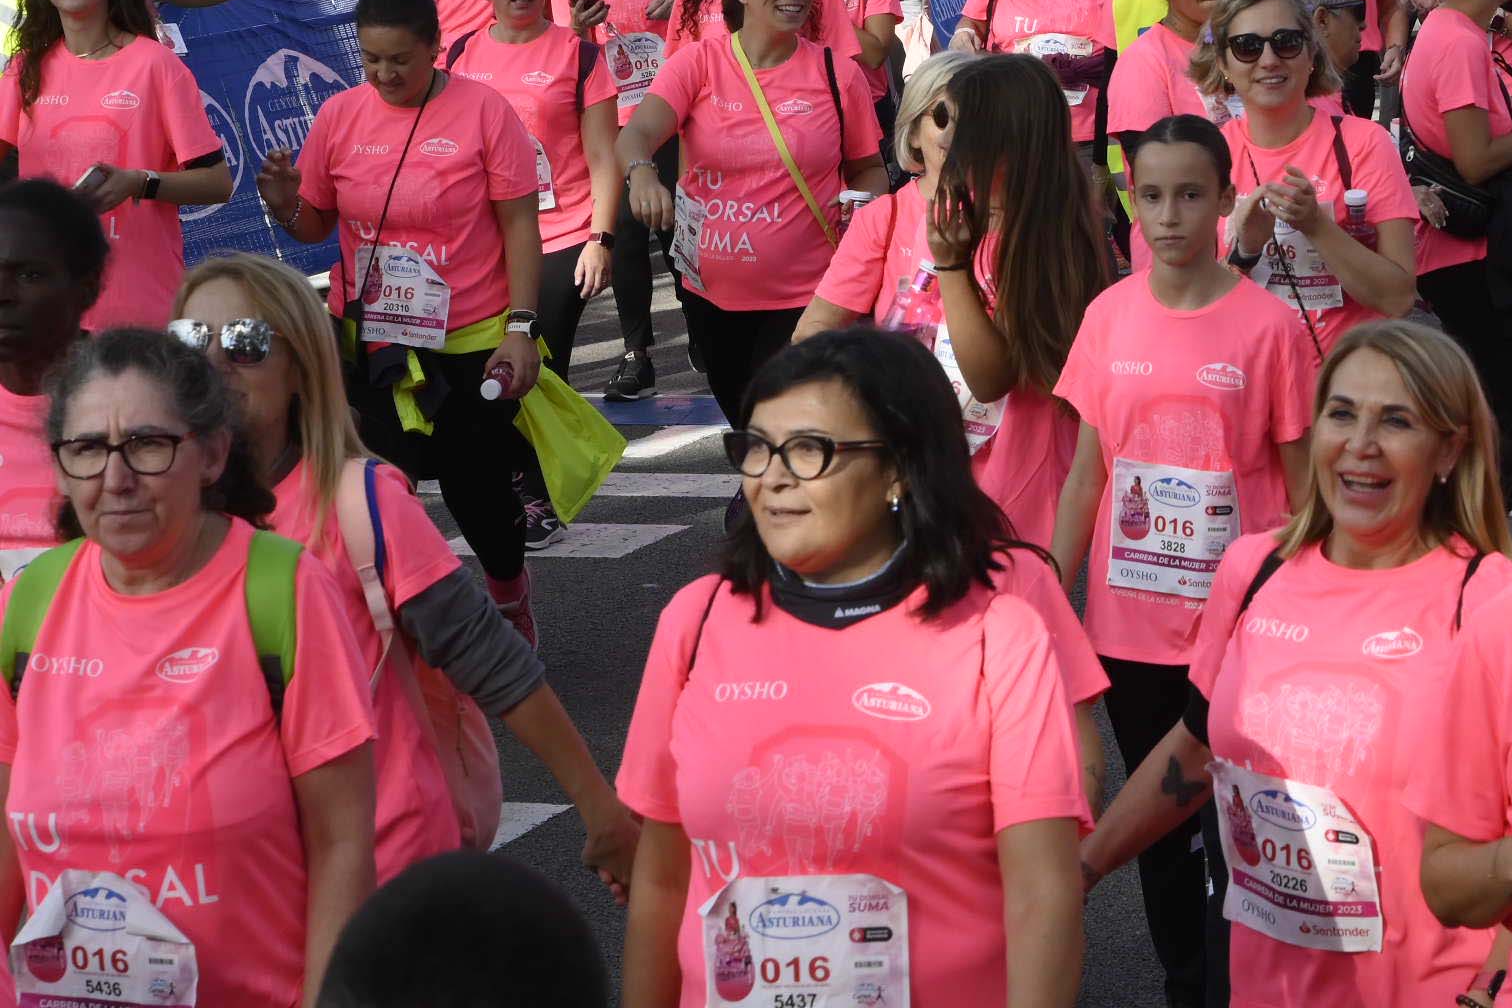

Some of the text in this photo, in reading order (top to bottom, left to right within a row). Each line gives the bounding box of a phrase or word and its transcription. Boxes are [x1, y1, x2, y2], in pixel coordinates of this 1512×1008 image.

[1014, 16, 1037, 33] TU
[635, 59, 658, 70] 016
[694, 167, 722, 190] TU
[699, 228, 754, 253] UMA
[383, 284, 415, 300] 016
[1300, 293, 1334, 302] antander
[363, 313, 385, 321] ARRERA
[384, 302, 410, 313] 20310
[362, 327, 386, 335] YSHO
[1111, 360, 1153, 377] OYSHO
[1153, 484, 1197, 503] ASTURIANA
[1154, 515, 1194, 537] 016
[1160, 540, 1186, 554] 3828
[1124, 551, 1157, 563] CARRERA
[1158, 556, 1169, 565] DE
[1170, 558, 1180, 567] LA
[1181, 560, 1206, 570] MUJER
[1120, 567, 1158, 583] OYSHO
[1247, 617, 1309, 642] OYSHO
[31, 653, 104, 678] OYSHO
[715, 681, 788, 702] OYSHO
[858, 693, 925, 716] ASTURIANA
[9, 811, 62, 853] TU
[692, 839, 741, 880] TU
[1262, 838, 1313, 871] 016
[1269, 870, 1308, 893] 20226
[29, 863, 219, 920] DSAL
[849, 901, 890, 913] SUMA
[1241, 898, 1276, 926] OYSHO
[1286, 899, 1298, 909] LA
[1300, 901, 1334, 913] MUJER
[1337, 905, 1363, 915] 2023
[756, 912, 833, 929] ASTURIANA
[1312, 924, 1370, 937] Santander
[71, 946, 129, 972] 016
[760, 956, 831, 984] 016
[85, 978, 122, 997] 5436
[774, 993, 817, 1008] 5437
